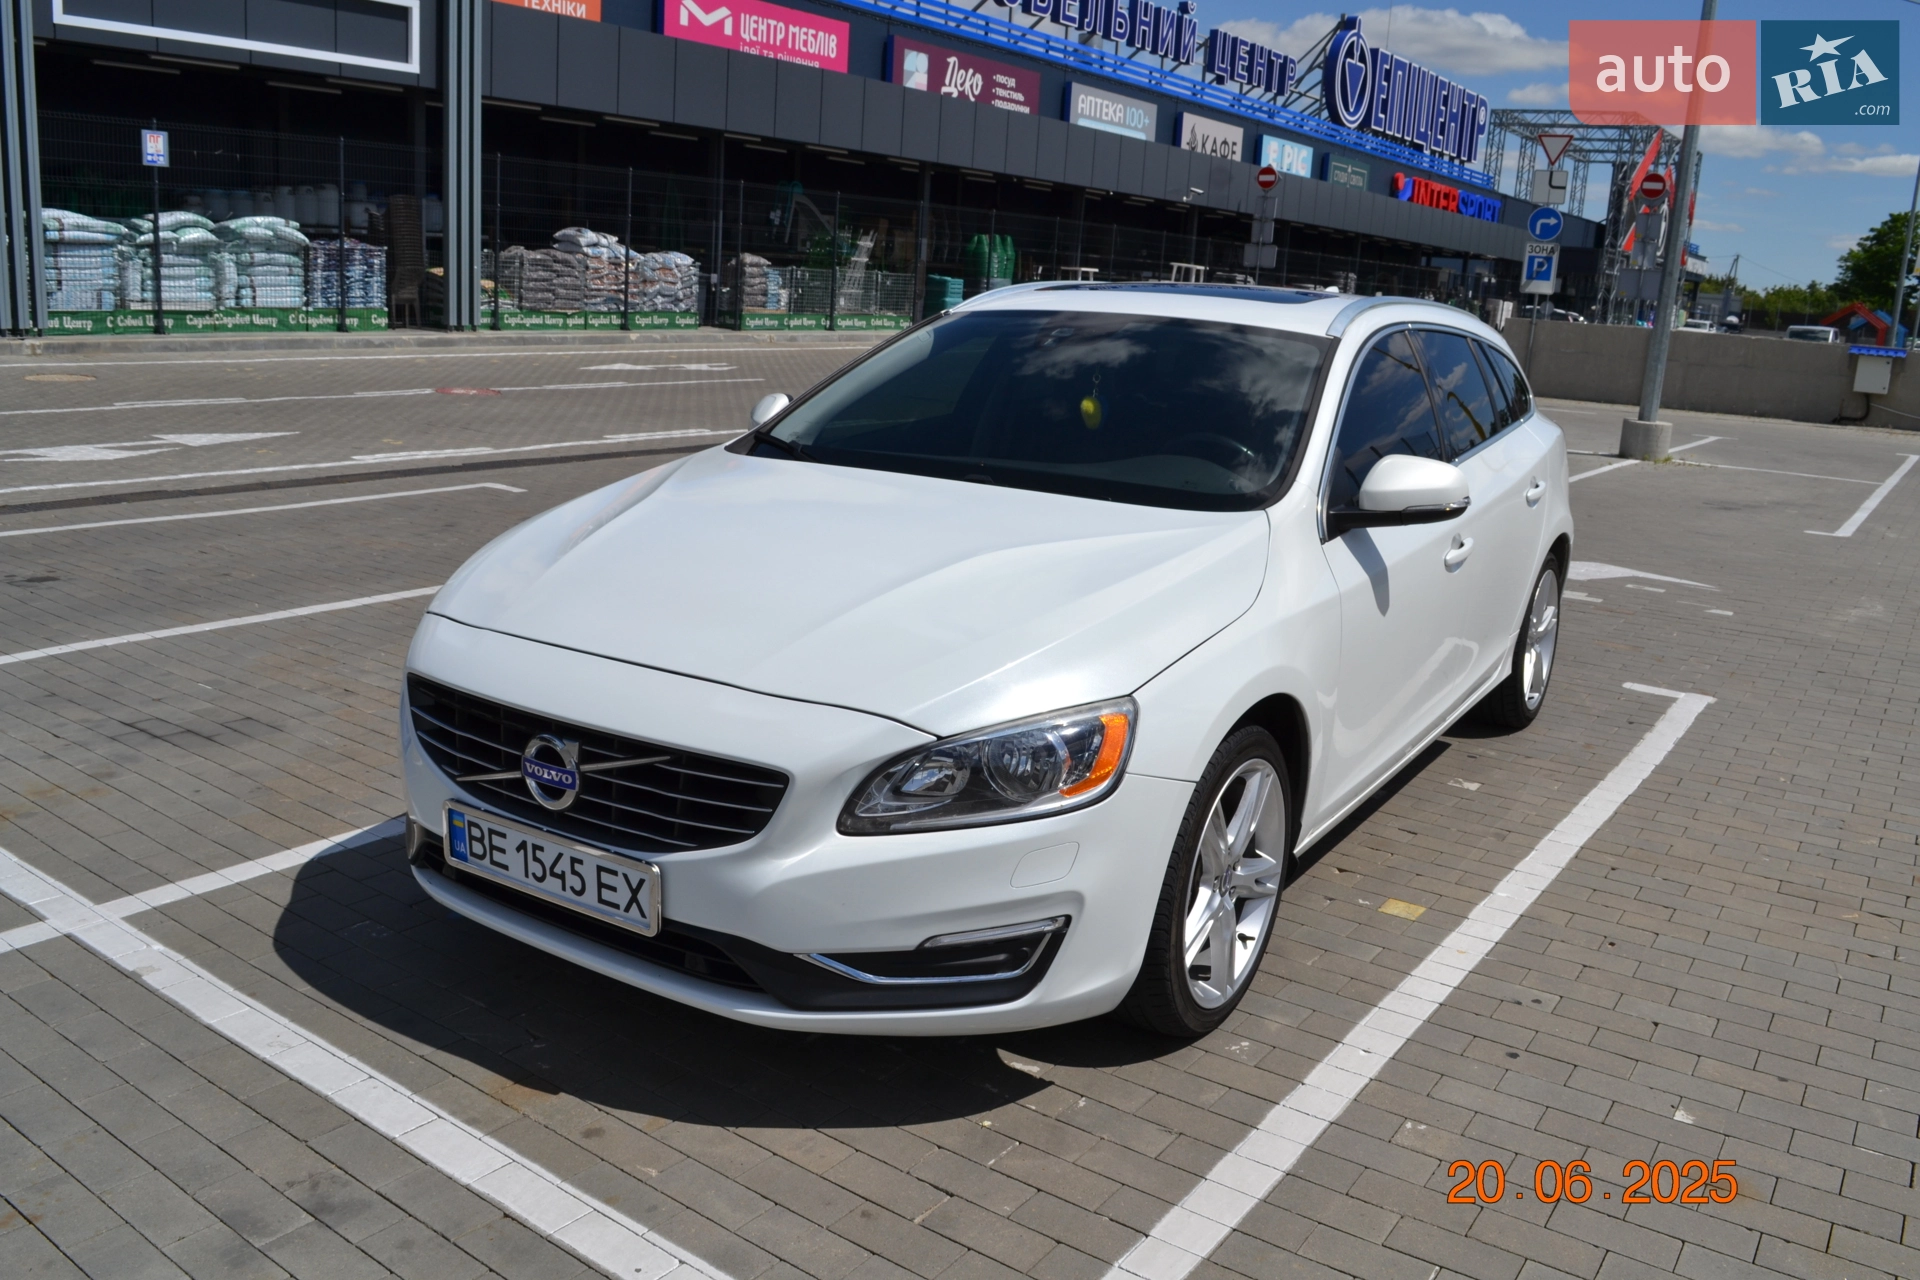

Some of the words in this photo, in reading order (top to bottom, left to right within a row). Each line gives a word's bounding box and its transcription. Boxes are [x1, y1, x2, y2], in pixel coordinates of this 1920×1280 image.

[740, 12, 785, 46] ЦЕНТР
[788, 23, 837, 59] МЕБЛІВ
[941, 56, 983, 102] Деко
[996, 74, 1016, 89] посуд
[1213, 28, 1298, 96] ЦЕНТР
[1078, 94, 1124, 124] АПТЕКА
[1125, 108, 1150, 129] 100+
[1371, 47, 1490, 164] ЕПІЦЕНТР
[1412, 176, 1502, 224] INTERSPORT
[1528, 244, 1556, 255] ЗОНА
[524, 762, 573, 785] VOLVO
[453, 840, 467, 855] UA
[466, 819, 510, 872] BE
[515, 839, 587, 897] 1545
[596, 864, 648, 920] EX
